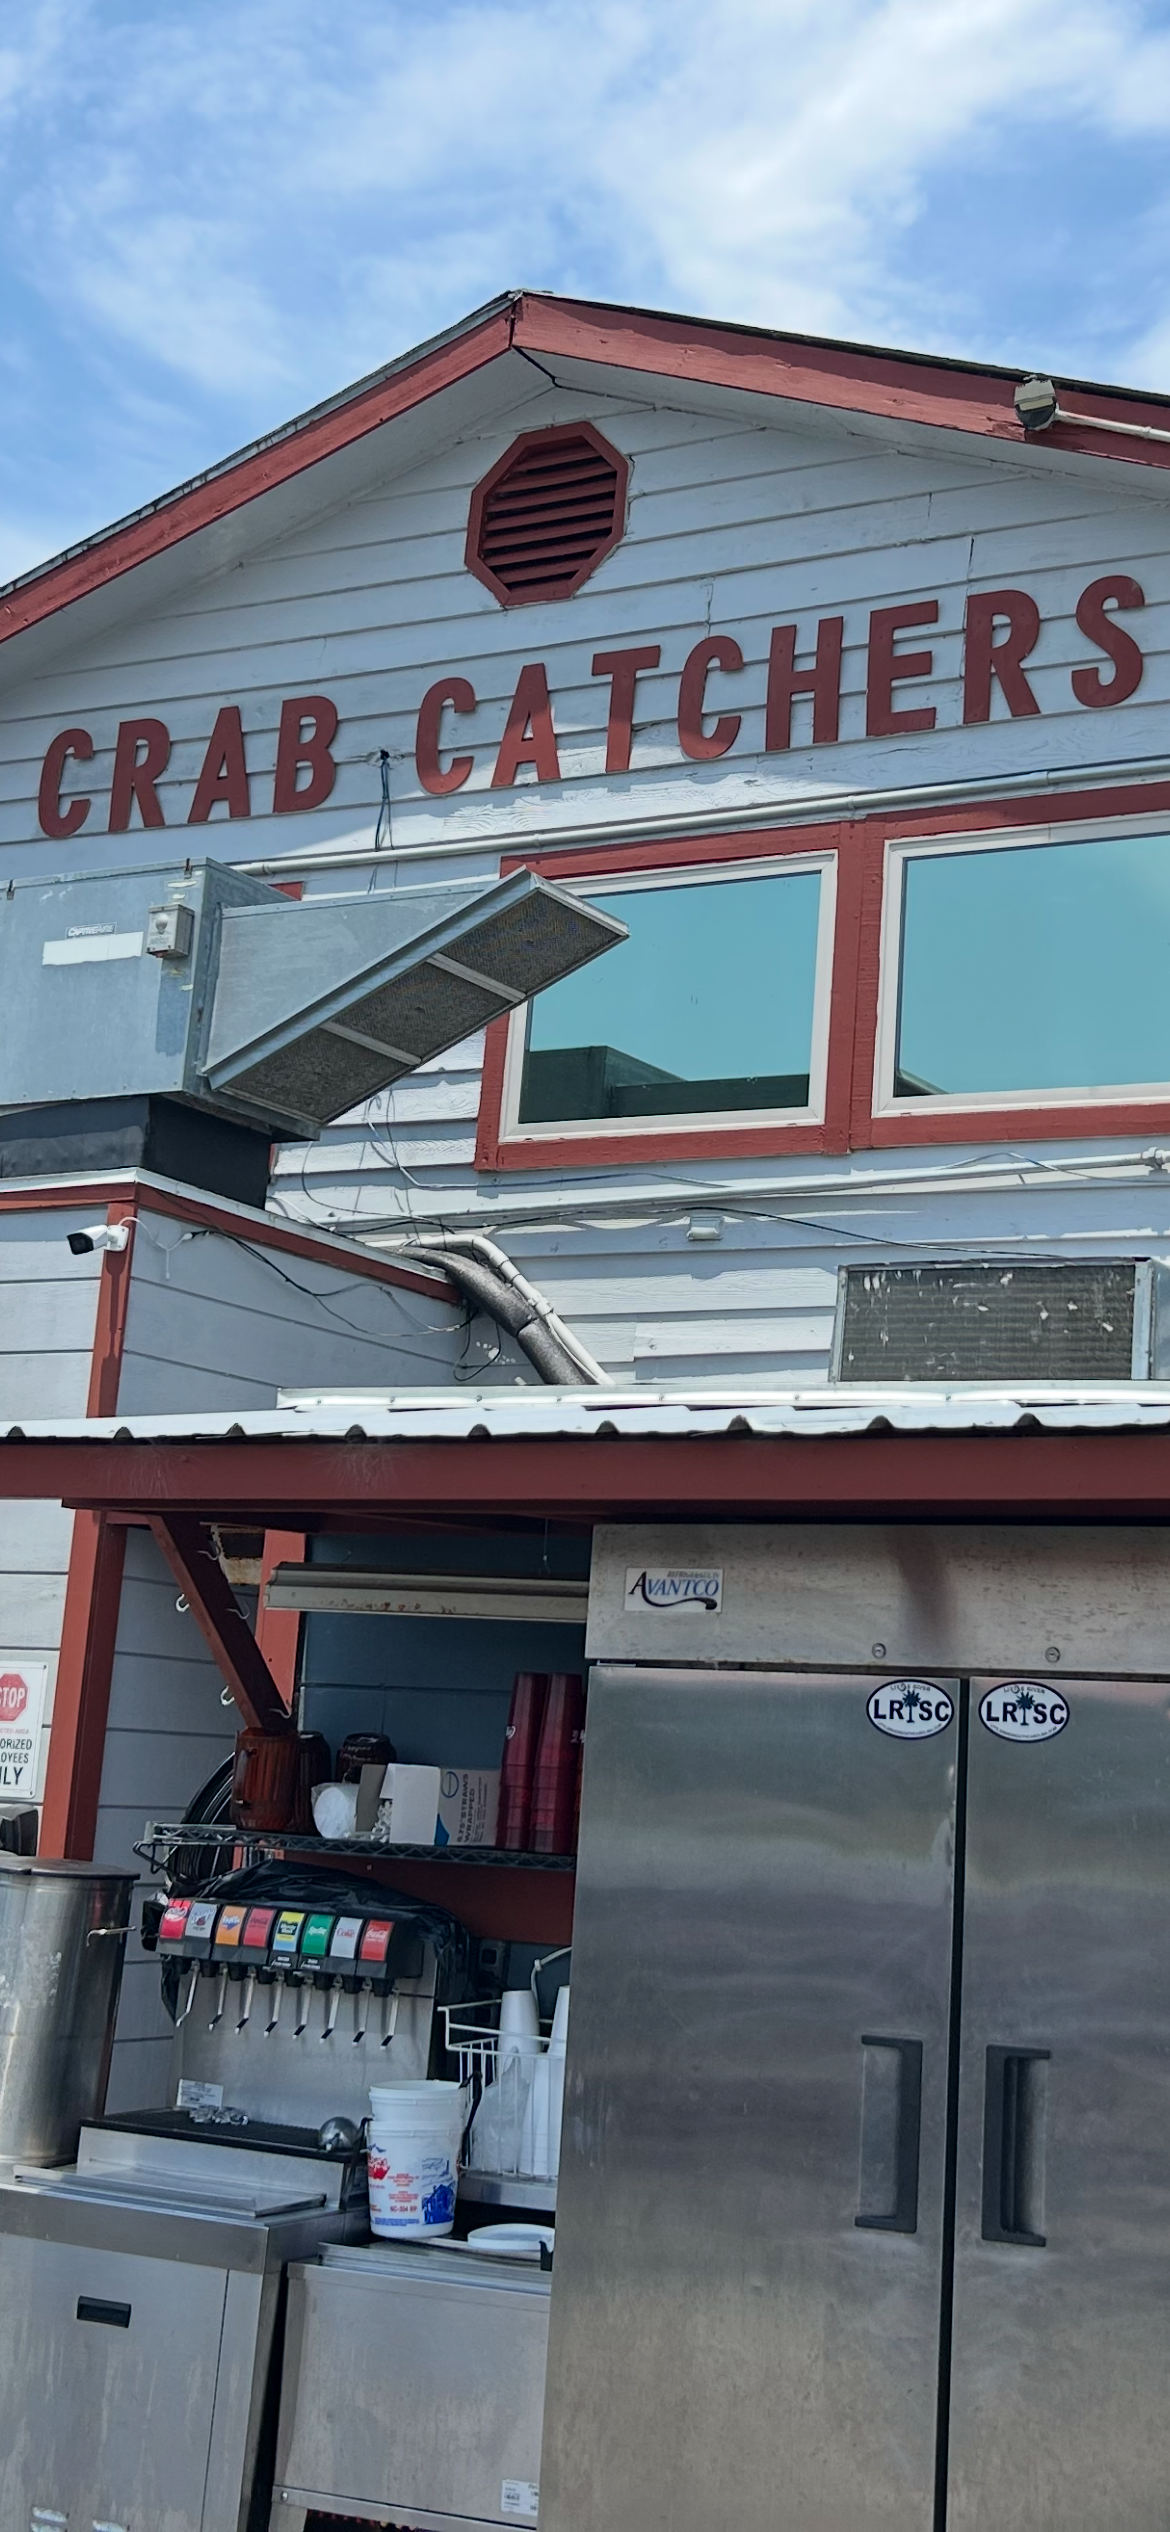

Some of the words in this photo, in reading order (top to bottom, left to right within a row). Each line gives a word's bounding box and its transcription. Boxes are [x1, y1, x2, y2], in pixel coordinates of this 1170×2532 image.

[38, 696, 338, 838] CRAB
[415, 575, 1146, 794] CATCHERS
[628, 1571, 719, 1598] AVANTCO
[874, 1699, 904, 1719] LR
[919, 1700, 950, 1721] SC
[986, 1701, 1018, 1722] LR
[1033, 1703, 1065, 1724] SC
[461, 1773, 469, 1818] STRAWS
[464, 1788, 475, 1843] WRAPPED
